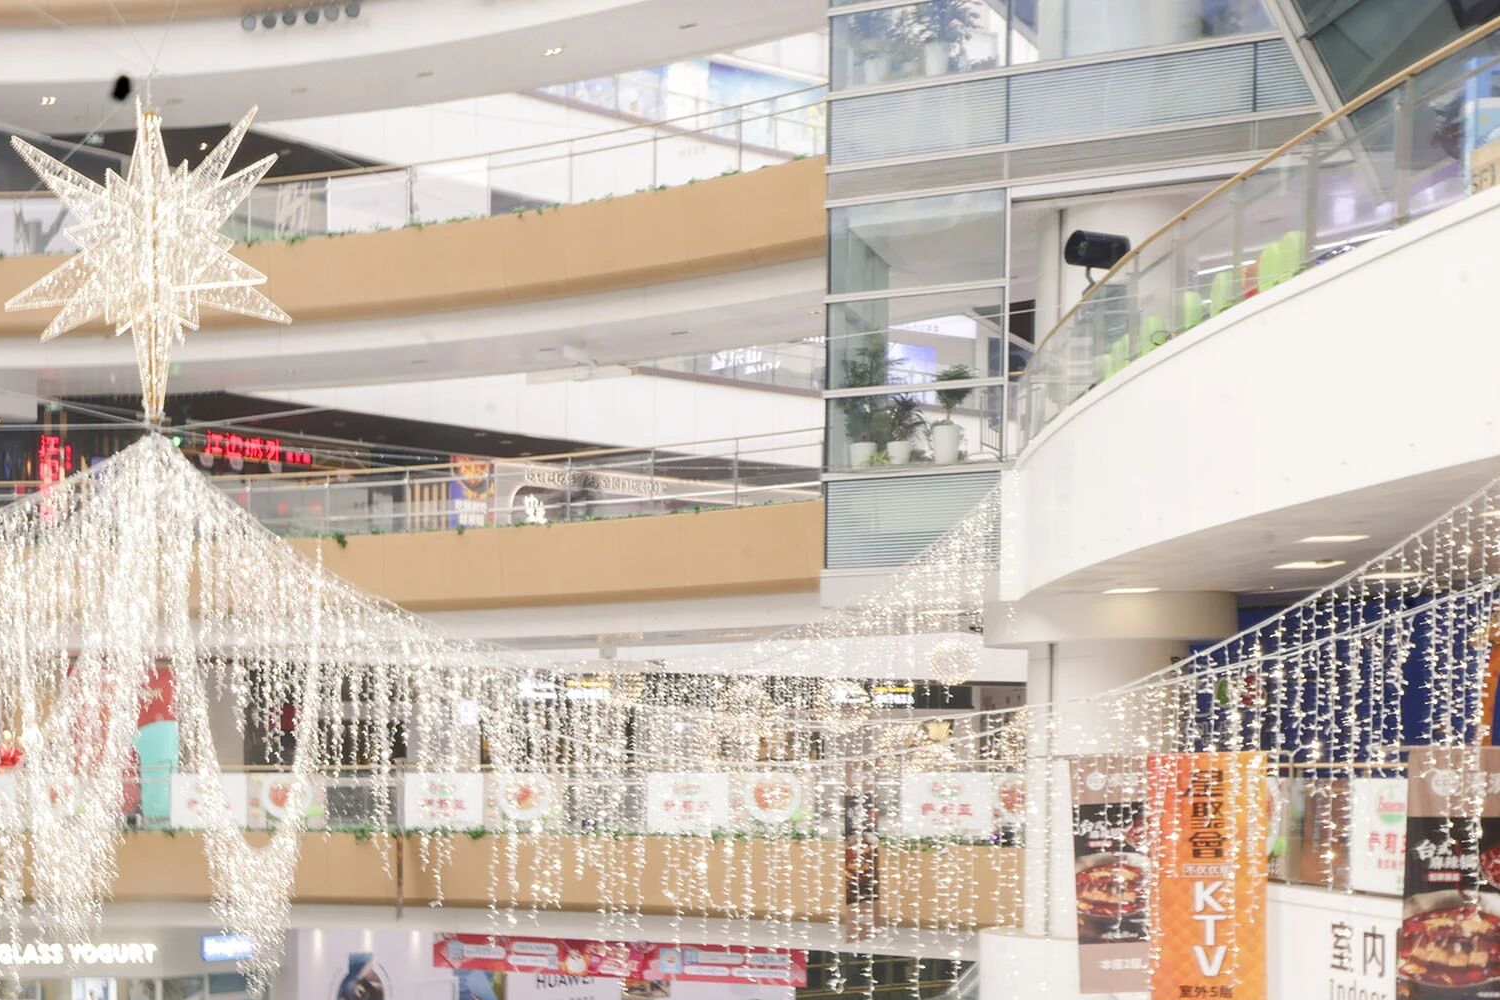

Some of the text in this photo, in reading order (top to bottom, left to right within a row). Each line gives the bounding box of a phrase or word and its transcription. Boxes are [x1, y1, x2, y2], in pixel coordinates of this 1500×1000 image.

[67, 943, 157, 966] YOGURT
[1192, 880, 1228, 977] KTV
[1329, 920, 1387, 978] 室内
